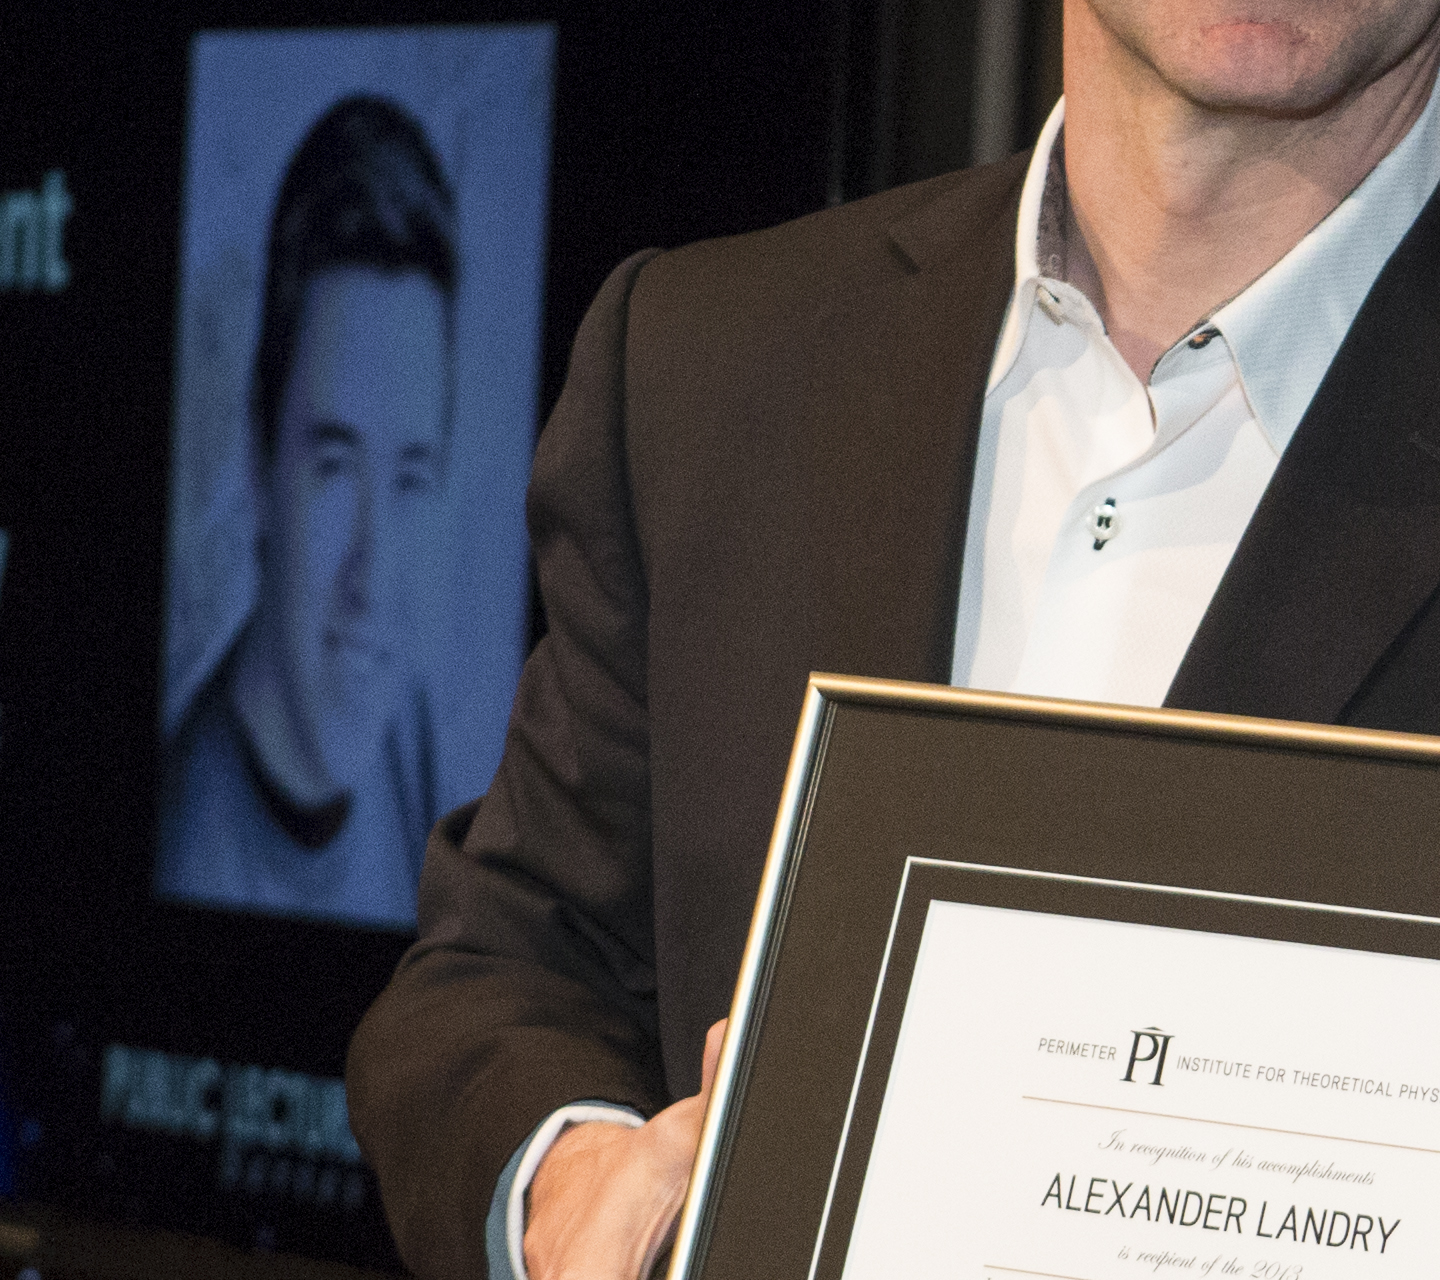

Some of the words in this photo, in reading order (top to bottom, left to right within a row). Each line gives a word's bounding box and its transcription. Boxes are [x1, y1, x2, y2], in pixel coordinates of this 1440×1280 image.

[1038, 1038, 1116, 1060] PERIMETER
[1176, 1055, 1251, 1079] INSTITUTE
[1256, 1065, 1286, 1083] FOR
[1292, 1070, 1393, 1097] THEORETICAL
[1098, 1129, 1125, 1151] In
[1130, 1141, 1207, 1166] recognition
[1211, 1149, 1229, 1170] of
[1231, 1150, 1253, 1169] his
[1257, 1159, 1376, 1186] accomplishments
[1041, 1172, 1247, 1234] ALEXANDER
[1256, 1200, 1401, 1254] LANDRY
[1118, 1245, 1129, 1260] is
[1136, 1248, 1196, 1273] recipient
[1201, 1254, 1219, 1276] of
[1221, 1255, 1245, 1276] the
